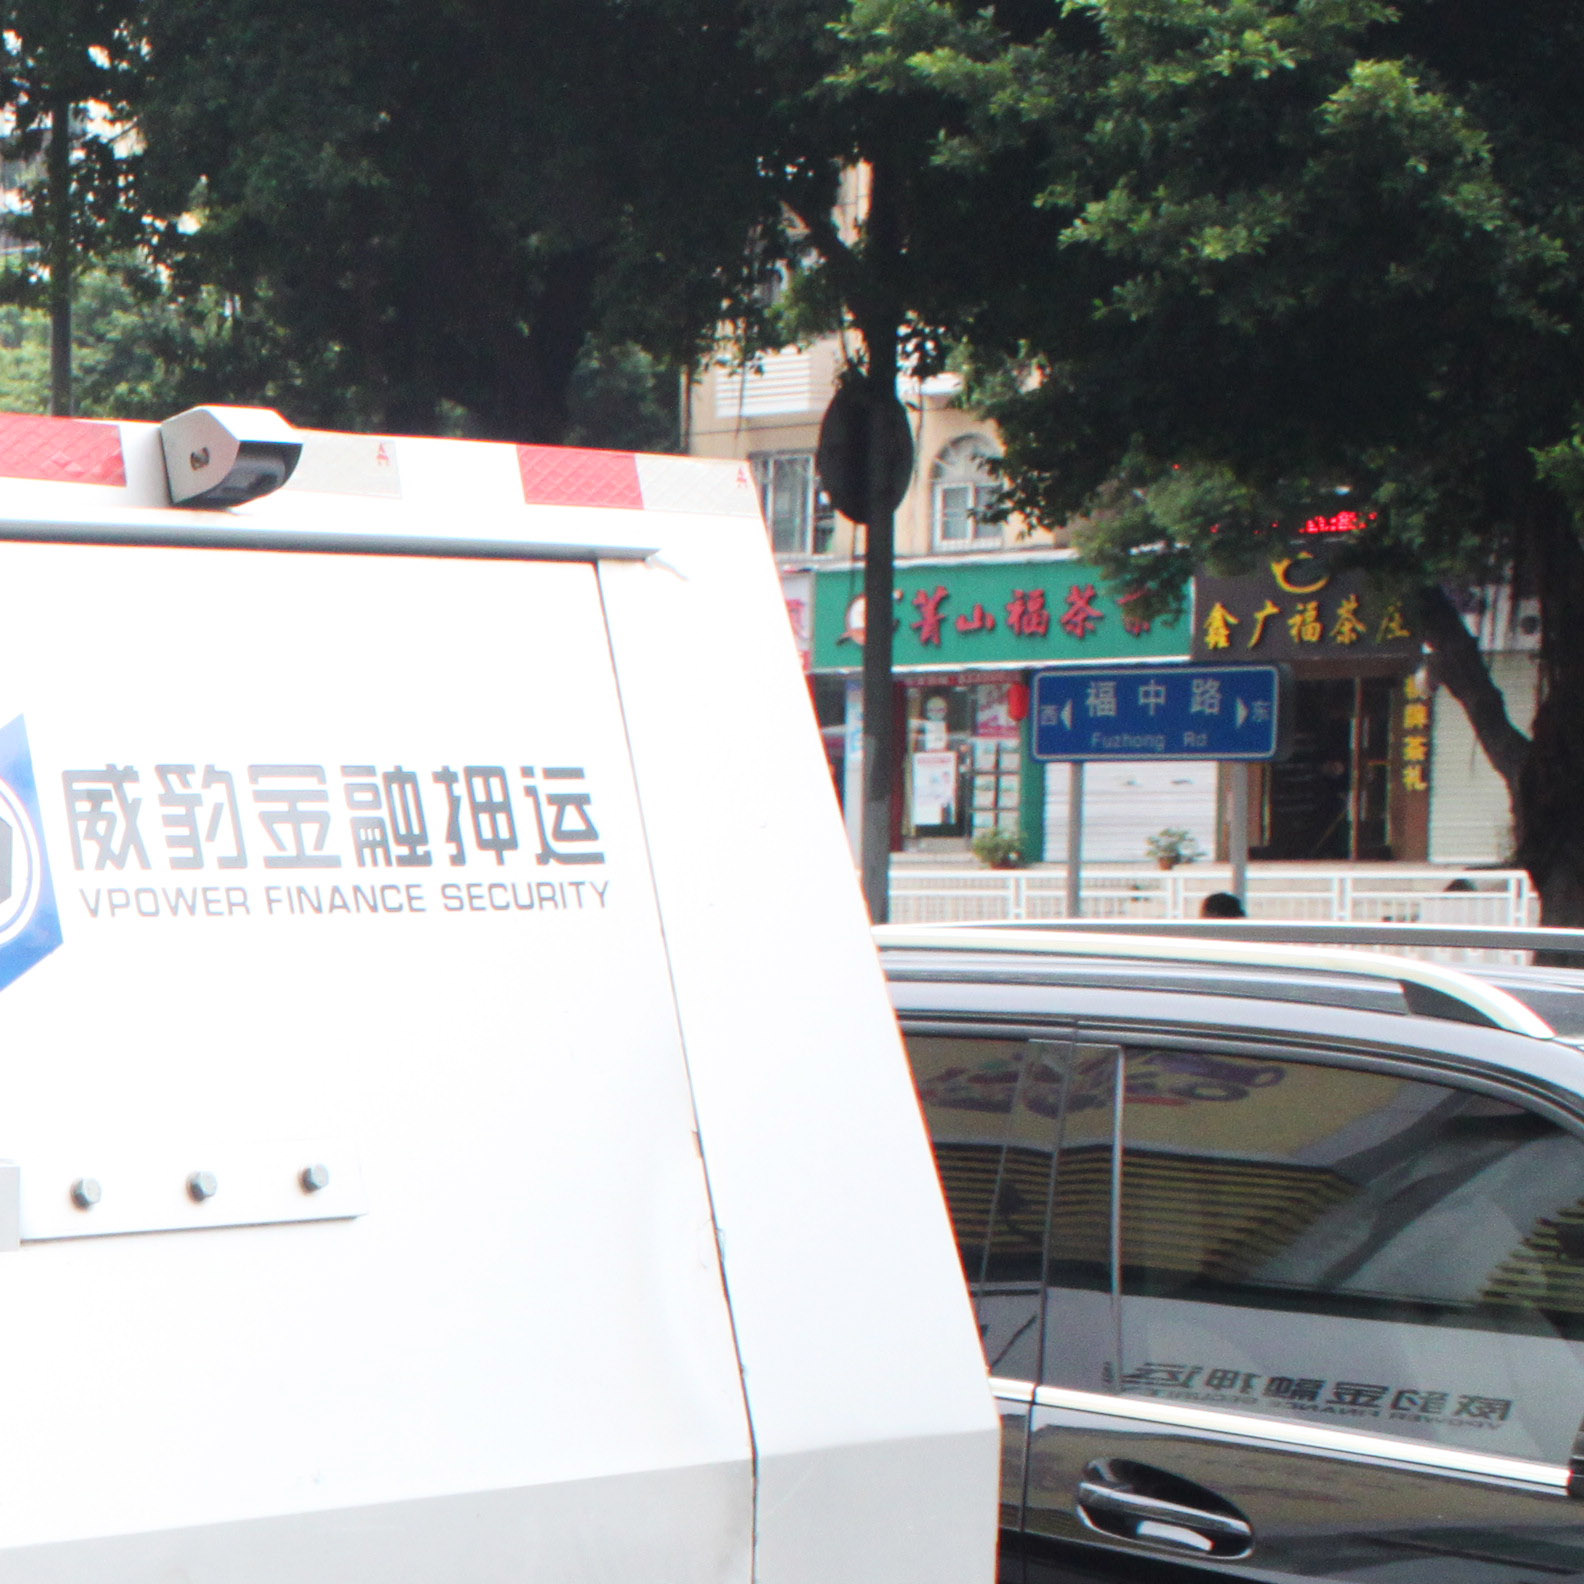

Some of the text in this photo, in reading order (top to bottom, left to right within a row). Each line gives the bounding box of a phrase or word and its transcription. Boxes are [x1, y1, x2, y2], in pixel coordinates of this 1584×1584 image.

[1040, 704, 1059, 727] 西
[1085, 678, 1221, 718] 福中路
[1090, 731, 1209, 752] Fuzhong Rd
[61, 763, 607, 871] 威豹金融押运
[78, 880, 611, 919] VPOWER FINANCE SECURITY
